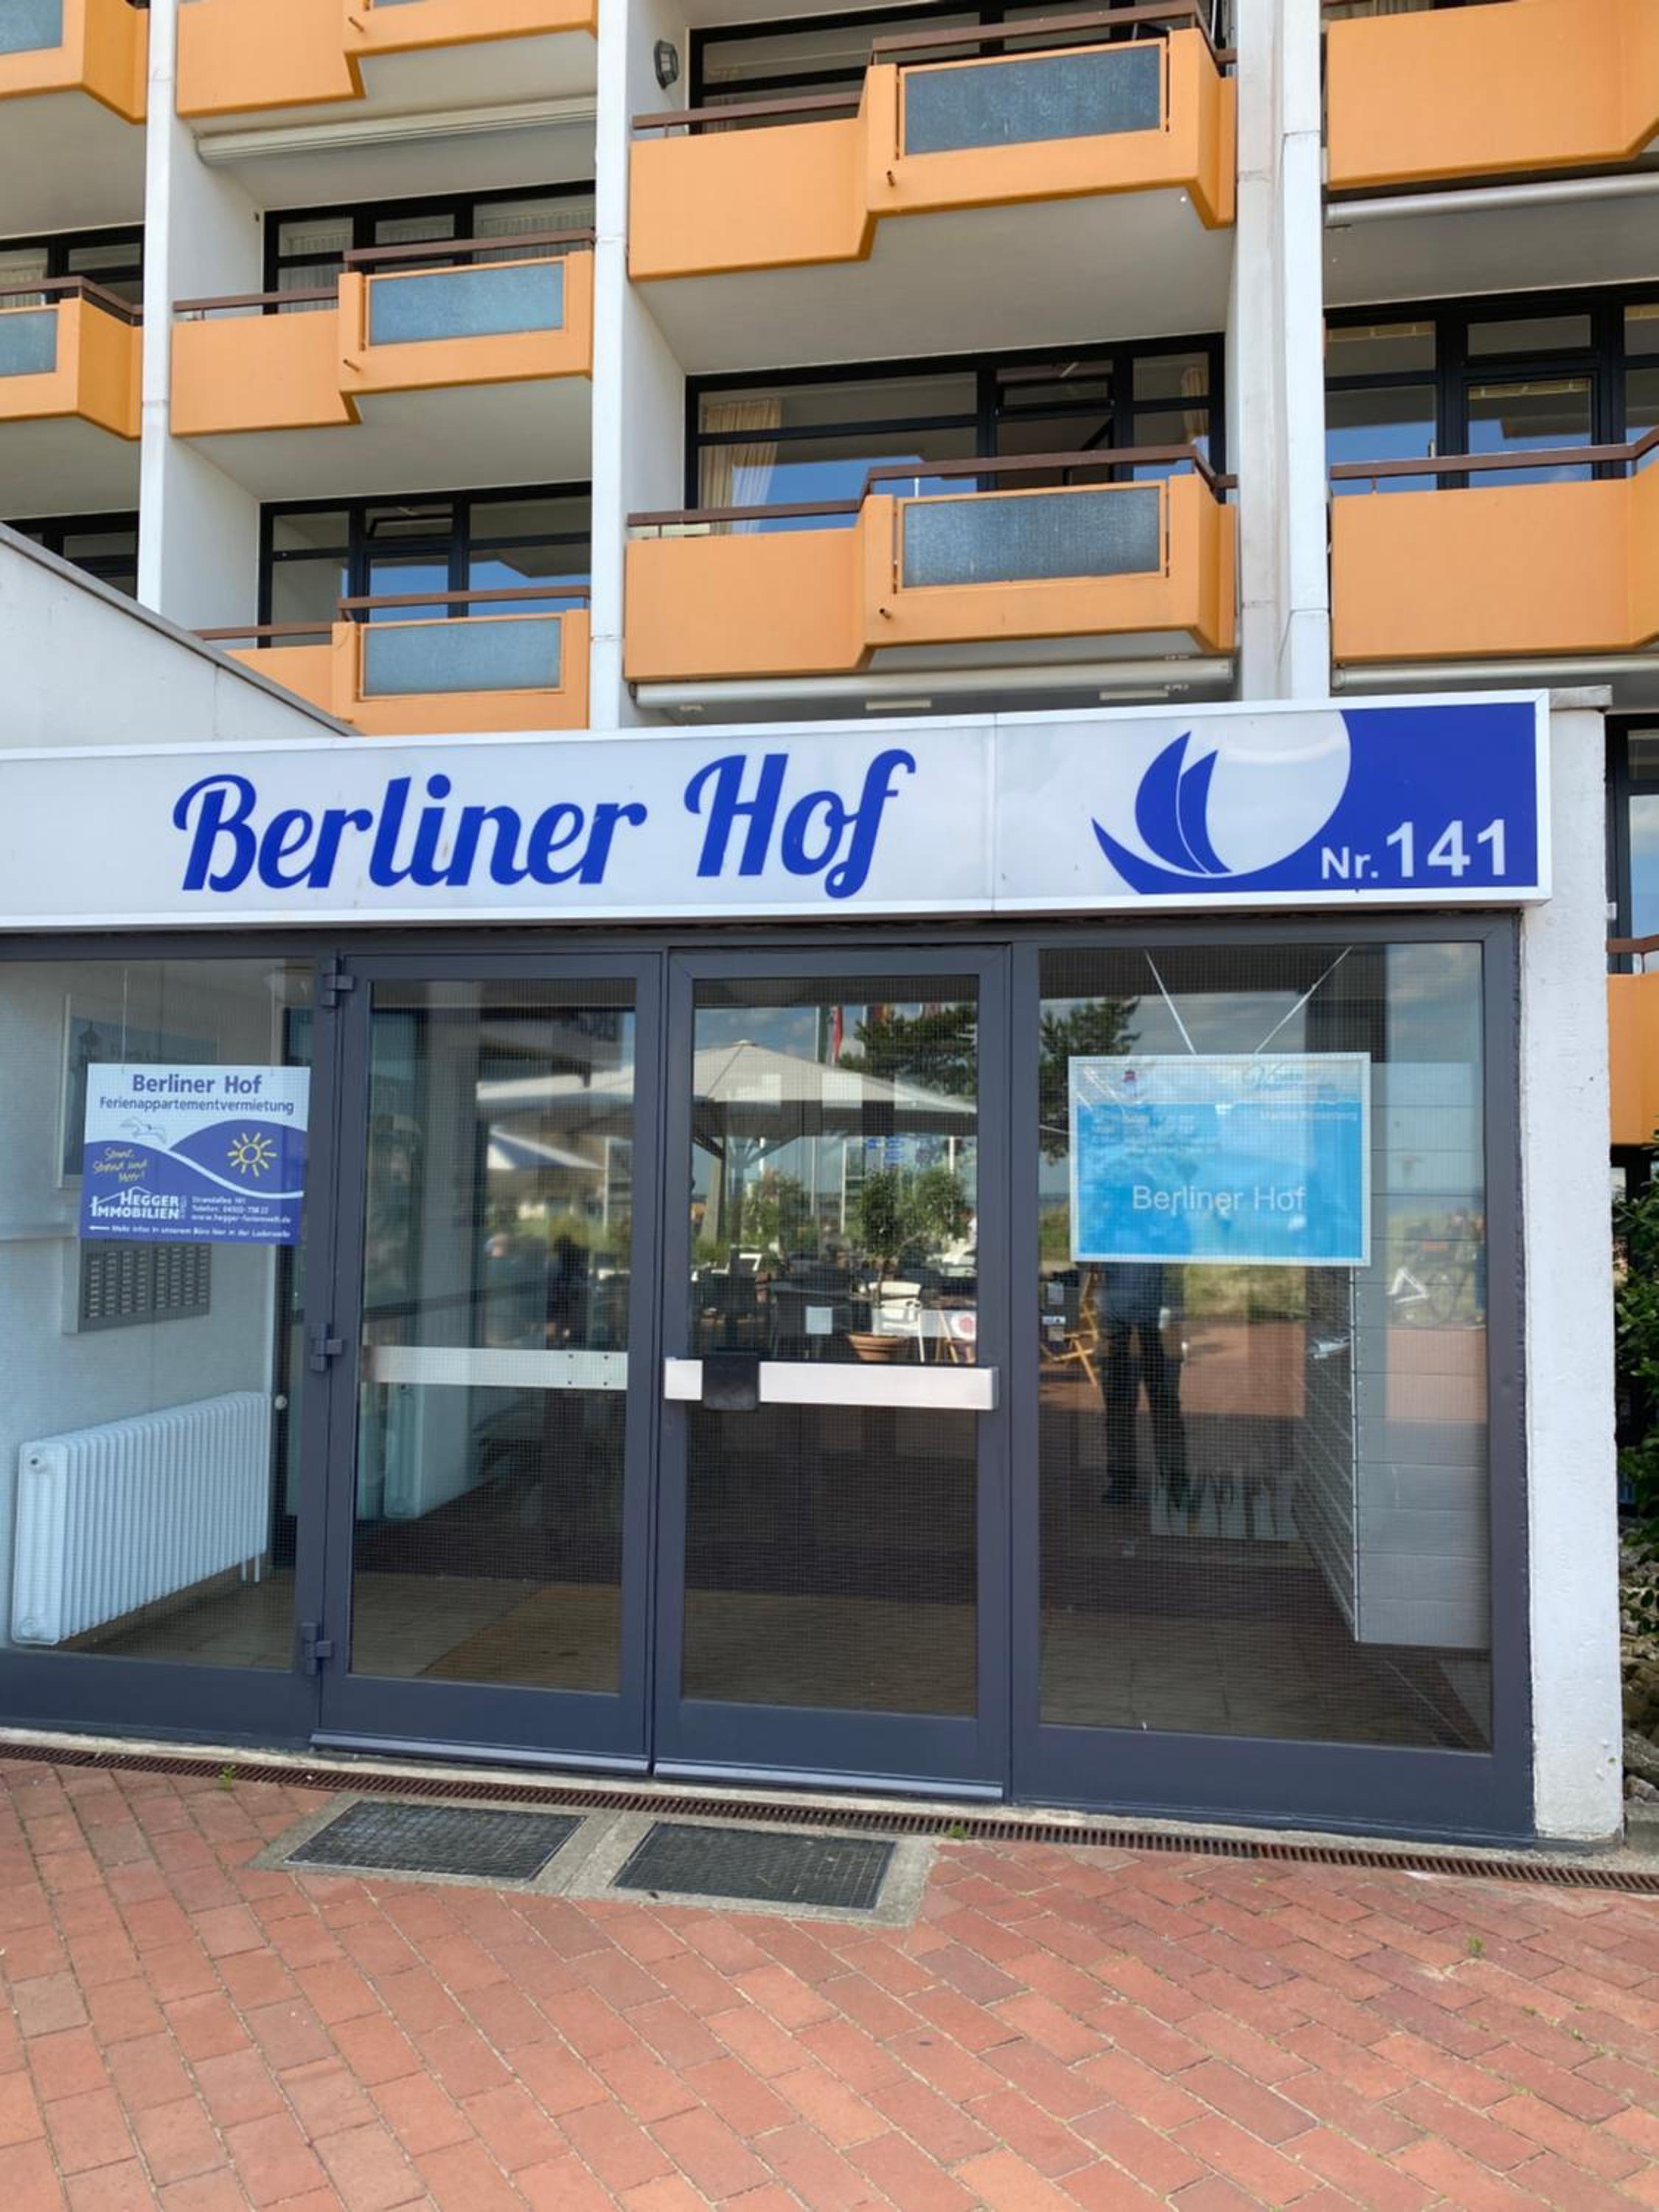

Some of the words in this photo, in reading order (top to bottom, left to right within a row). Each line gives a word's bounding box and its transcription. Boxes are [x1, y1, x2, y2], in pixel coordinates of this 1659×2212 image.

[173, 773, 647, 892] Berliner
[684, 748, 917, 900] Hof
[1321, 846, 1379, 879] Nr.
[1386, 818, 1506, 877] 141
[132, 1074, 215, 1093] Berliner
[224, 1074, 262, 1094] Hof
[100, 1096, 294, 1116] Ferienappartementvermietung
[91, 1195, 179, 1220] IMMOBILIEN
[119, 1189, 179, 1207] HEGGER
[1132, 1185, 1244, 1211] Berliner
[1254, 1185, 1307, 1211] Hof
